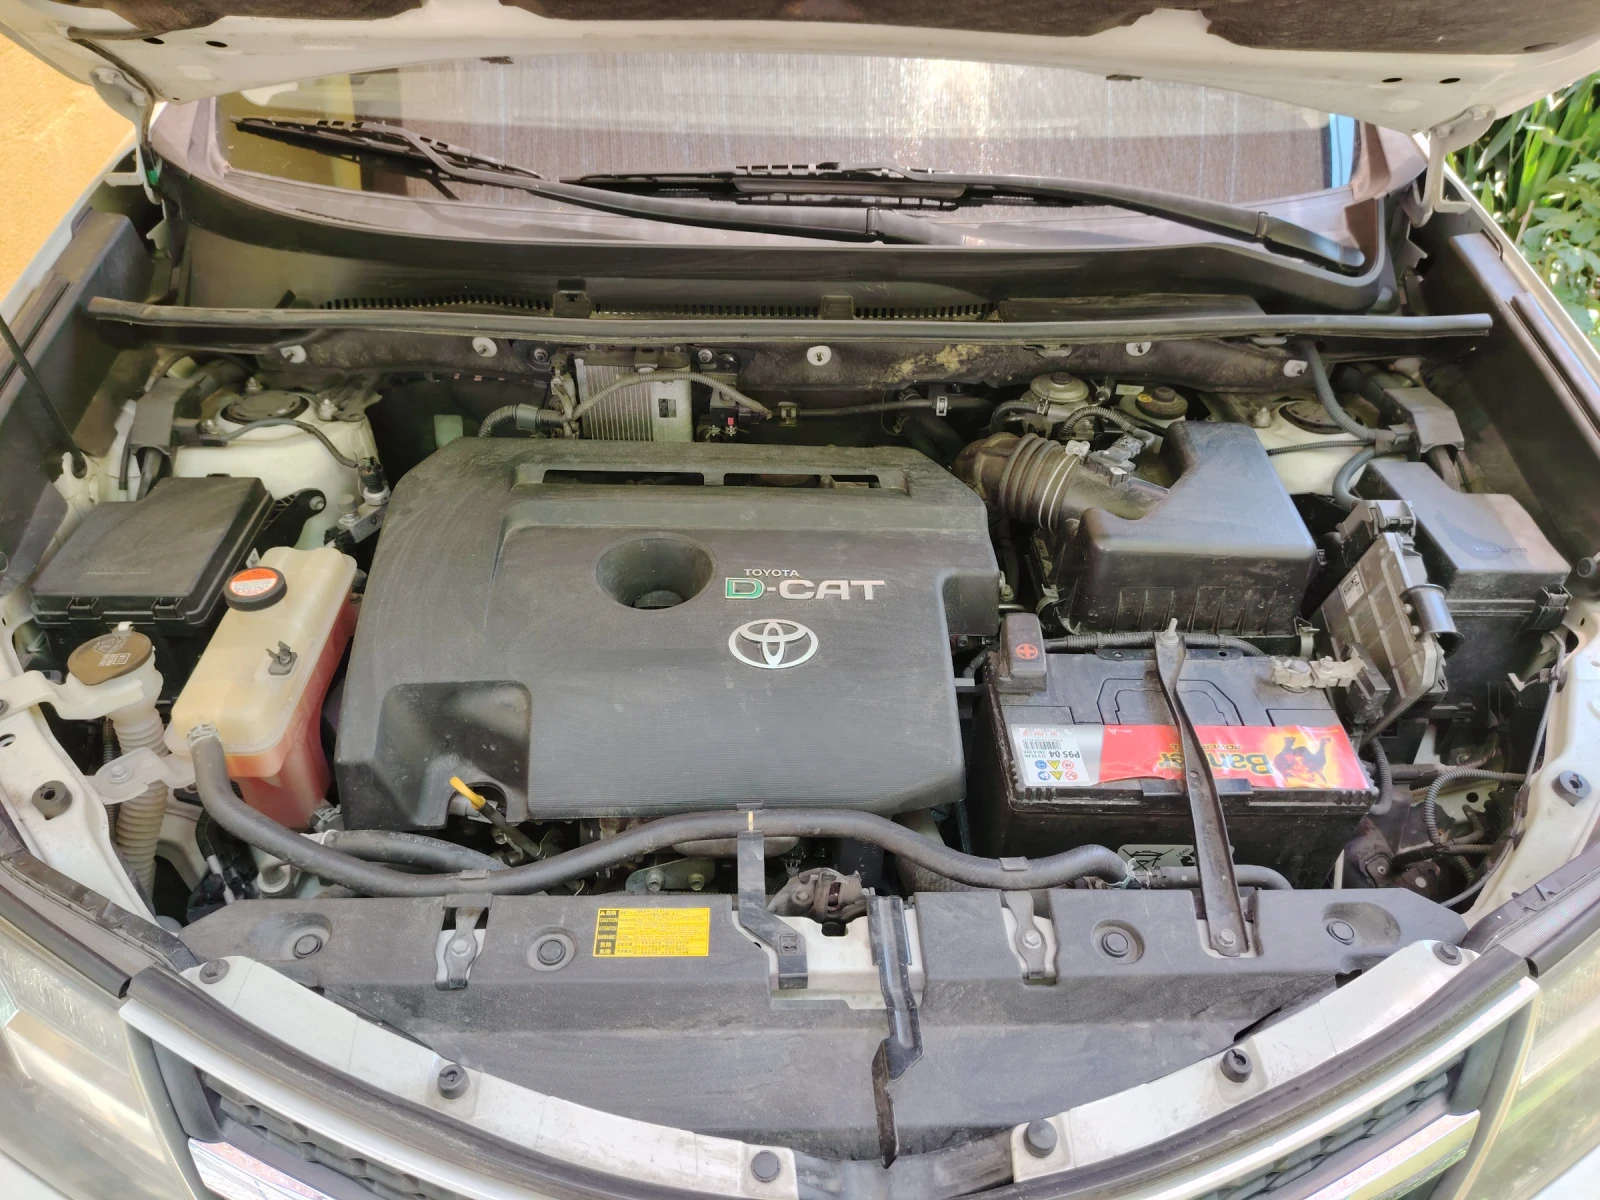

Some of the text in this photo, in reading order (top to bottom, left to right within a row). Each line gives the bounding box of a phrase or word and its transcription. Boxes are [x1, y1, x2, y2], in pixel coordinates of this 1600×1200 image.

[744, 568, 800, 577] TOYOTA
[725, 577, 886, 600] D-CAT
[1049, 750, 1060, 758] 04
[1063, 751, 1080, 759] P95
[1159, 753, 1274, 776] Baner
